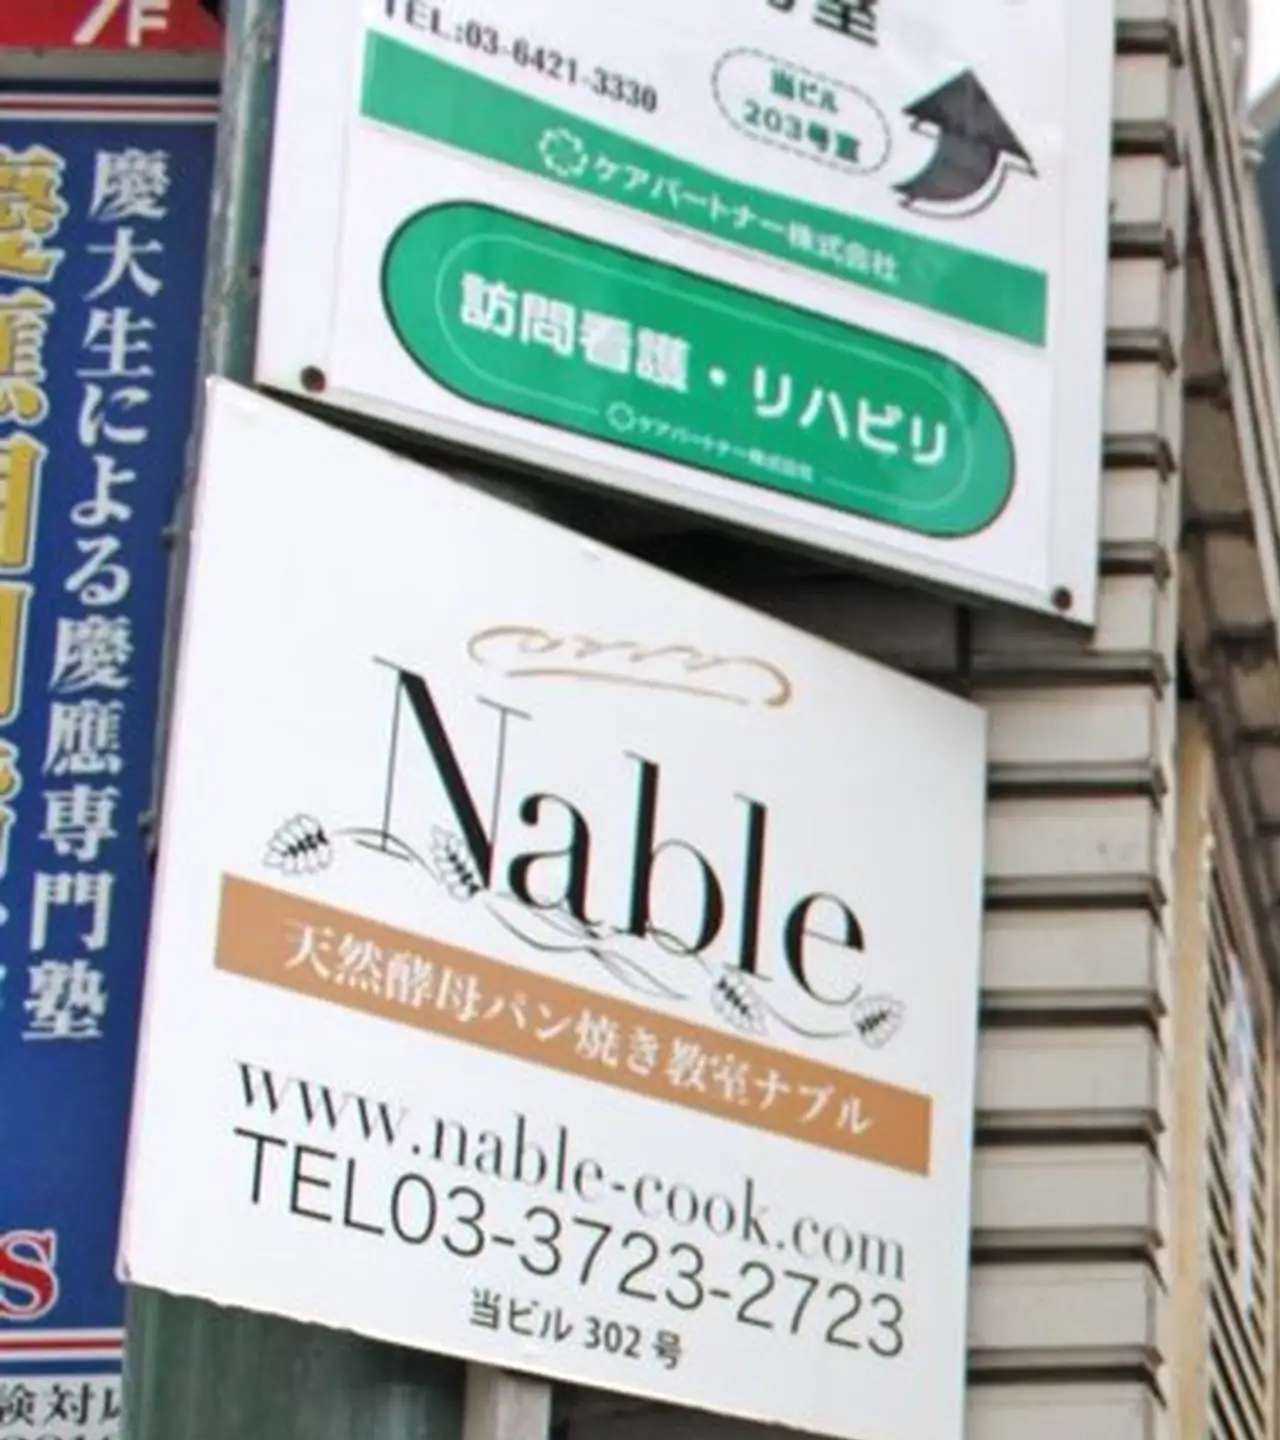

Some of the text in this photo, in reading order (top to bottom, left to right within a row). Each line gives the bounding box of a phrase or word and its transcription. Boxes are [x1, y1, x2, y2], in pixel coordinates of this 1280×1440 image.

[593, 155, 897, 285] ケアパートナー株式会社
[459, 272, 946, 466] 訪問看護・リハビリ
[372, 655, 868, 1006] Nable
[283, 917, 874, 1136] 天然酵母パン焼き教室ナブル
[233, 1060, 906, 1281] www.nable-cook.com
[233, 1127, 905, 1360] TEL03-3723-2723
[470, 1287, 573, 1342] 当ビル
[584, 1316, 642, 1358] 302
